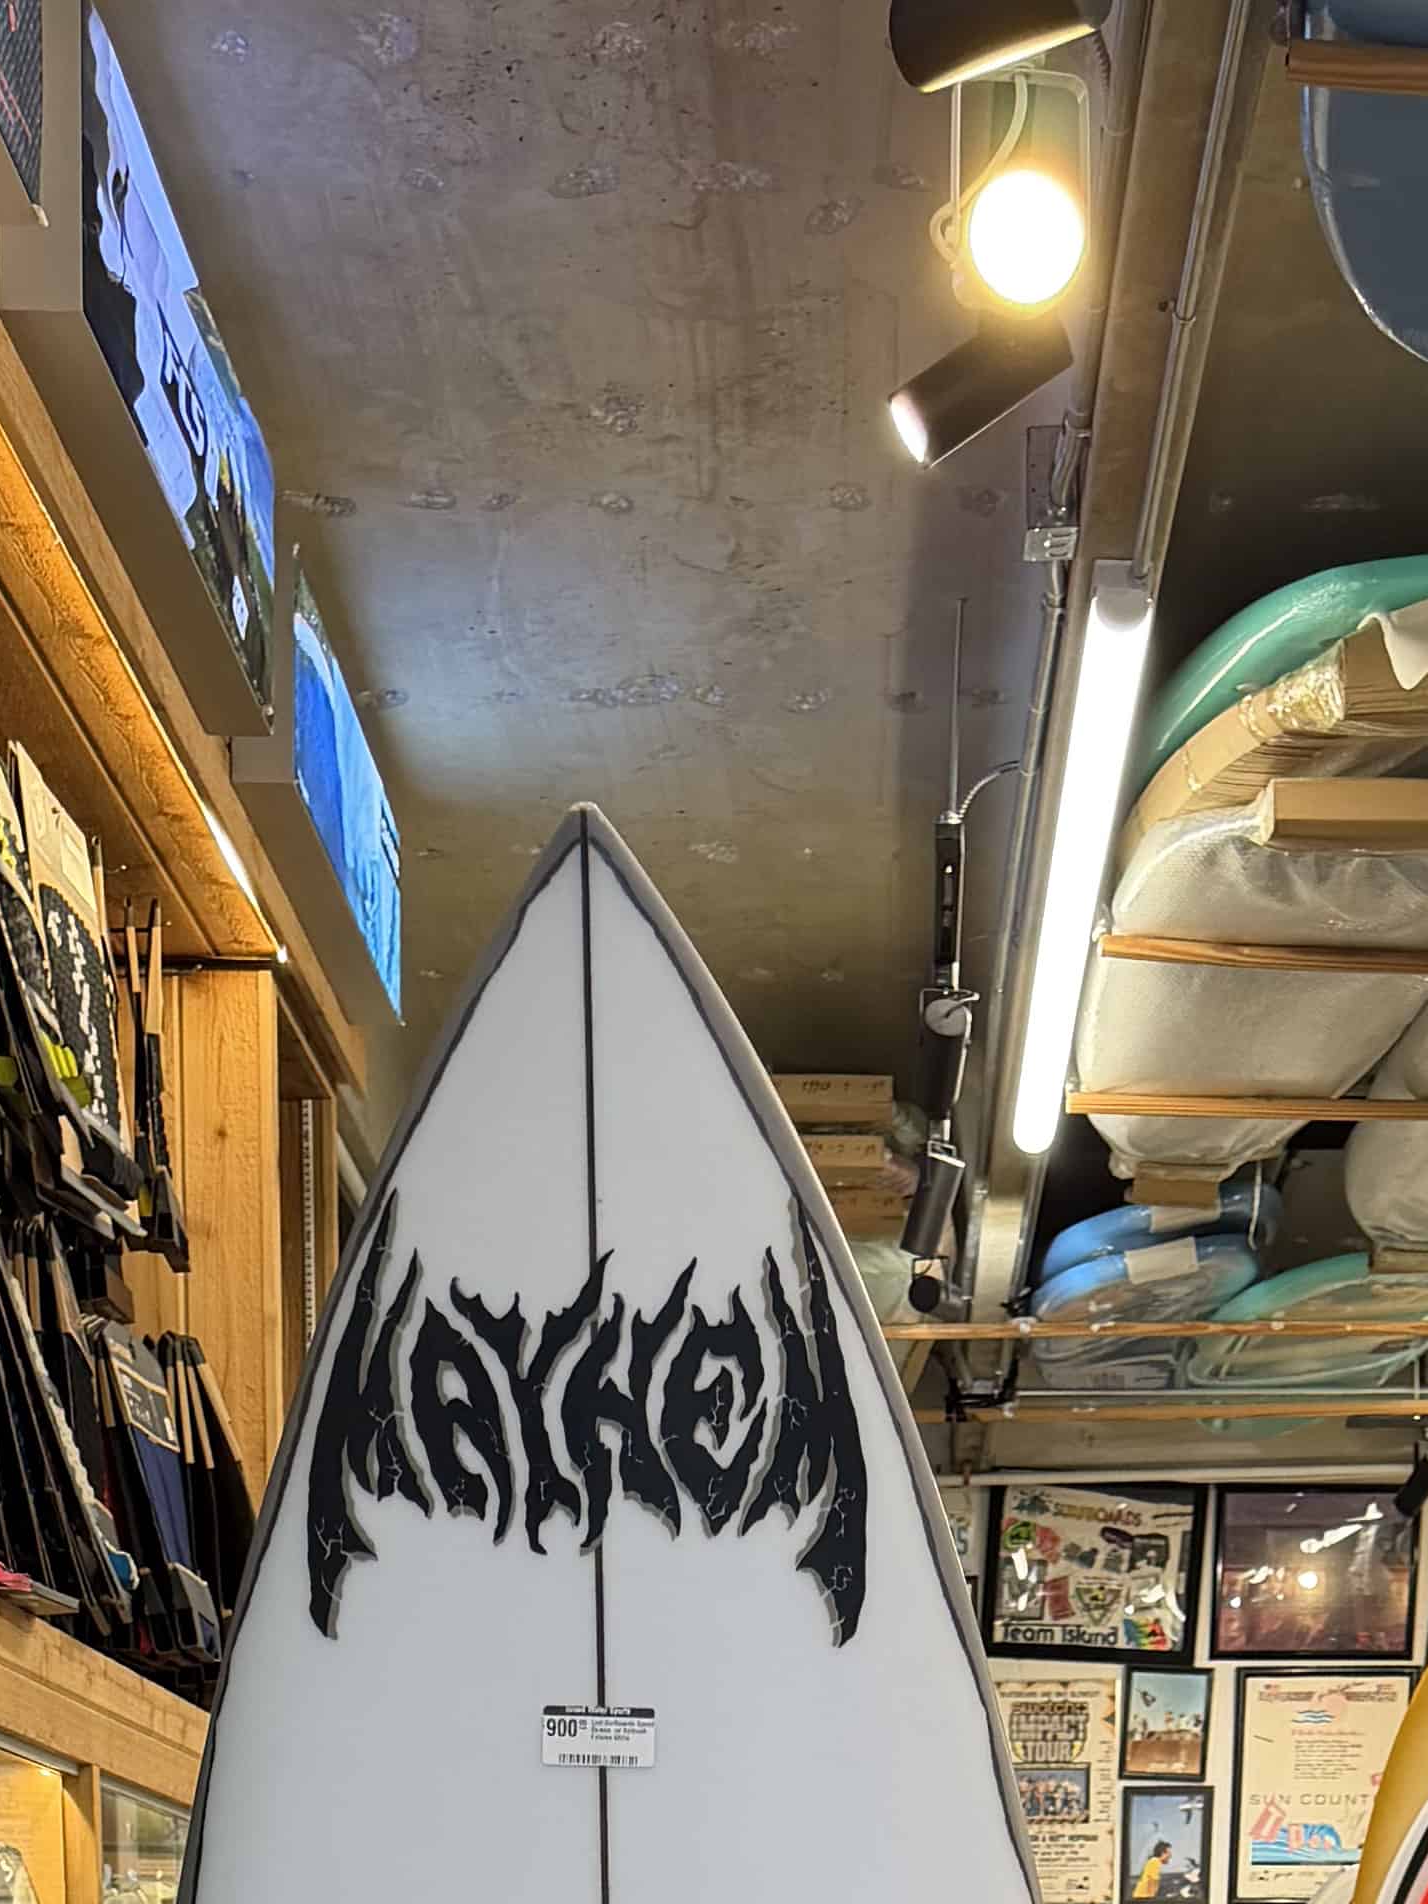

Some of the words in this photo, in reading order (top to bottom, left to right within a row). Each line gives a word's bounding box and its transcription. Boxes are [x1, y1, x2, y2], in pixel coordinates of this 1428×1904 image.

[306, 1187, 868, 1649] MAYHEM
[1002, 1623, 1056, 1644] Team
[1061, 1624, 1119, 1646] Island
[546, 1718, 577, 1737] 900
[1026, 1742, 1071, 1762] TOUR
[1248, 1793, 1292, 1806] SUN
